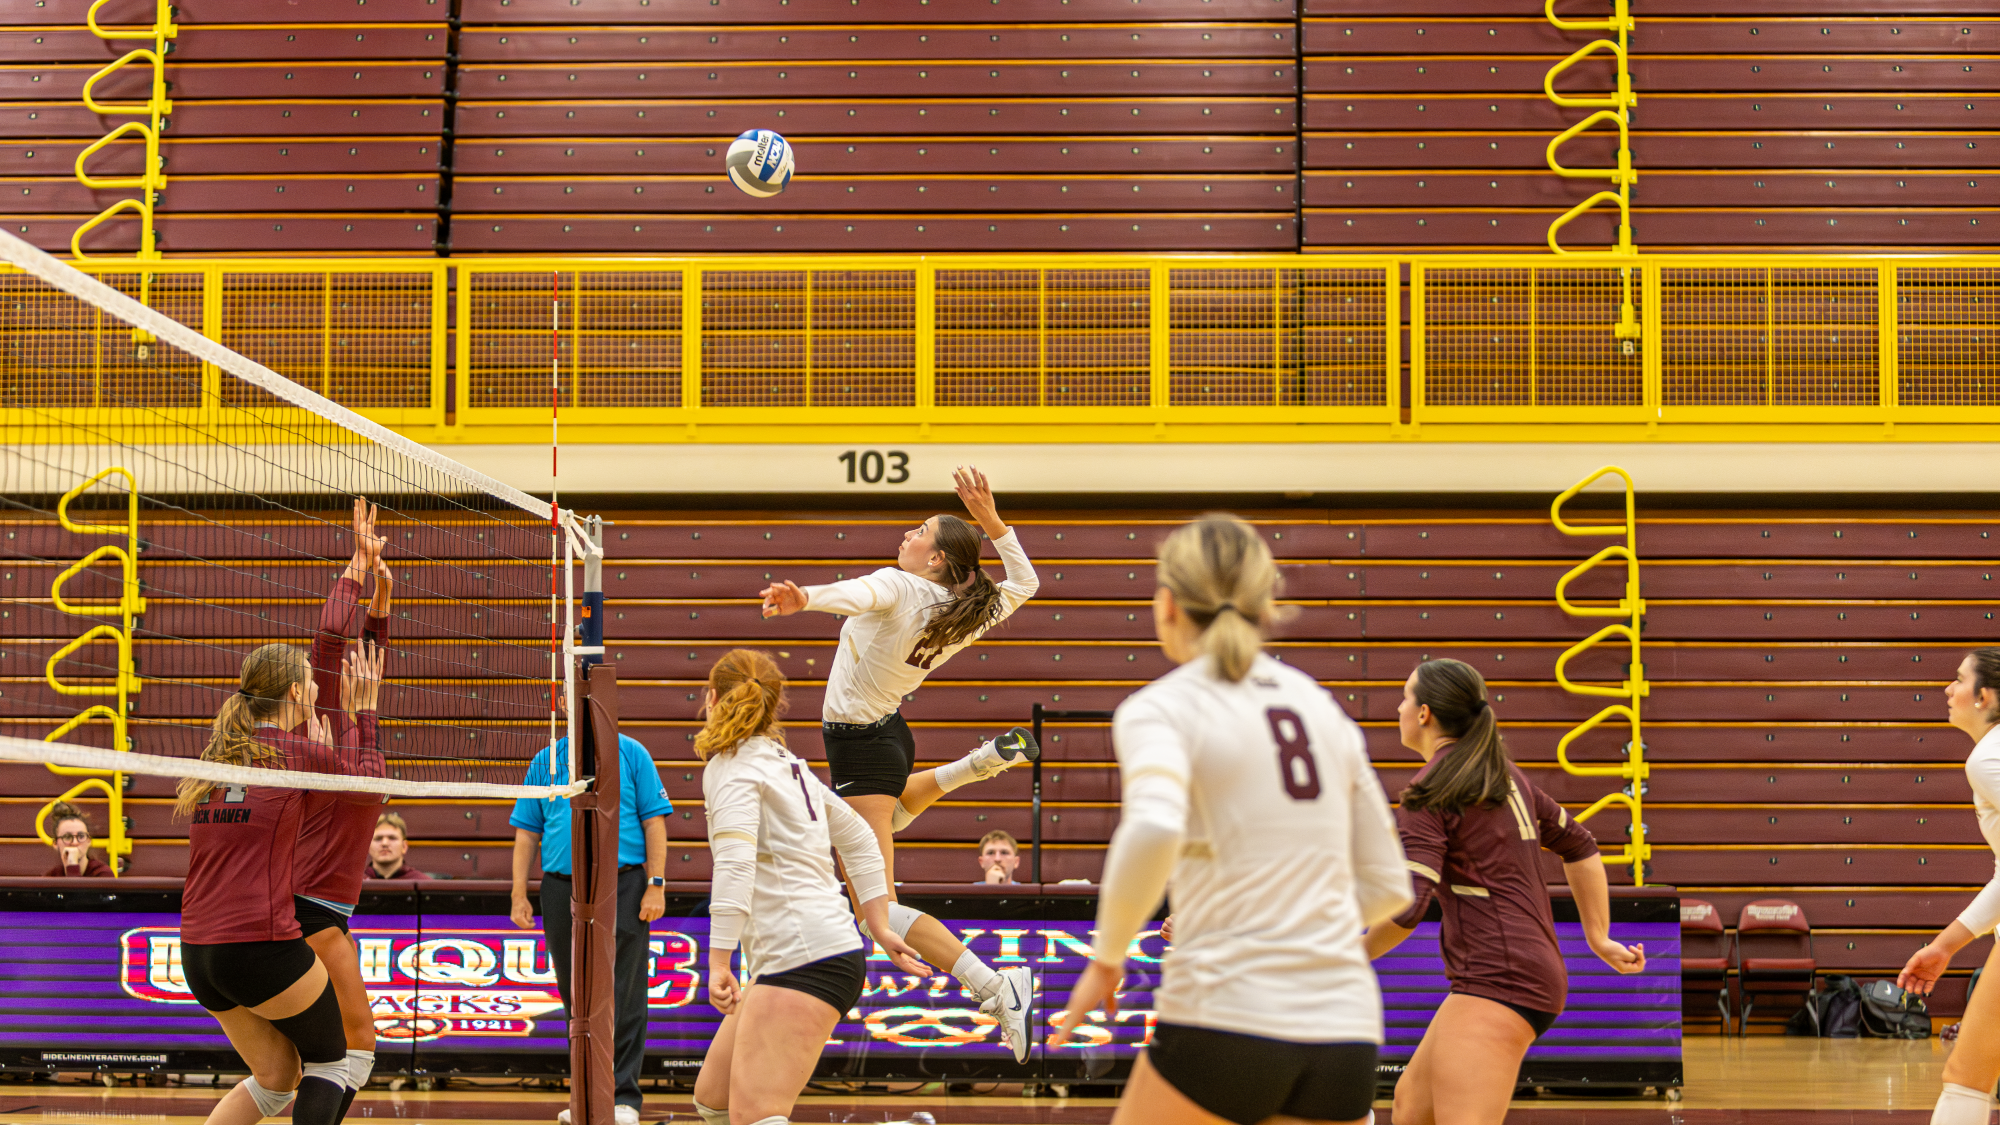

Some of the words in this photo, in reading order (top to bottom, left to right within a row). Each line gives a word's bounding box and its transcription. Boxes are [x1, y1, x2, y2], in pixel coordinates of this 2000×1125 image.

[767, 138, 784, 170] NCAA
[838, 450, 910, 483] 103
[1266, 708, 1321, 800] 8
[790, 763, 817, 821] 7
[213, 808, 251, 823] HAVEN
[1507, 777, 1537, 840] 11
[460, 1019, 512, 1031] 1921
[42, 1053, 160, 1063] SIDELINEINTERACTIVE.COM
[663, 1060, 704, 1068] SIDELINE
